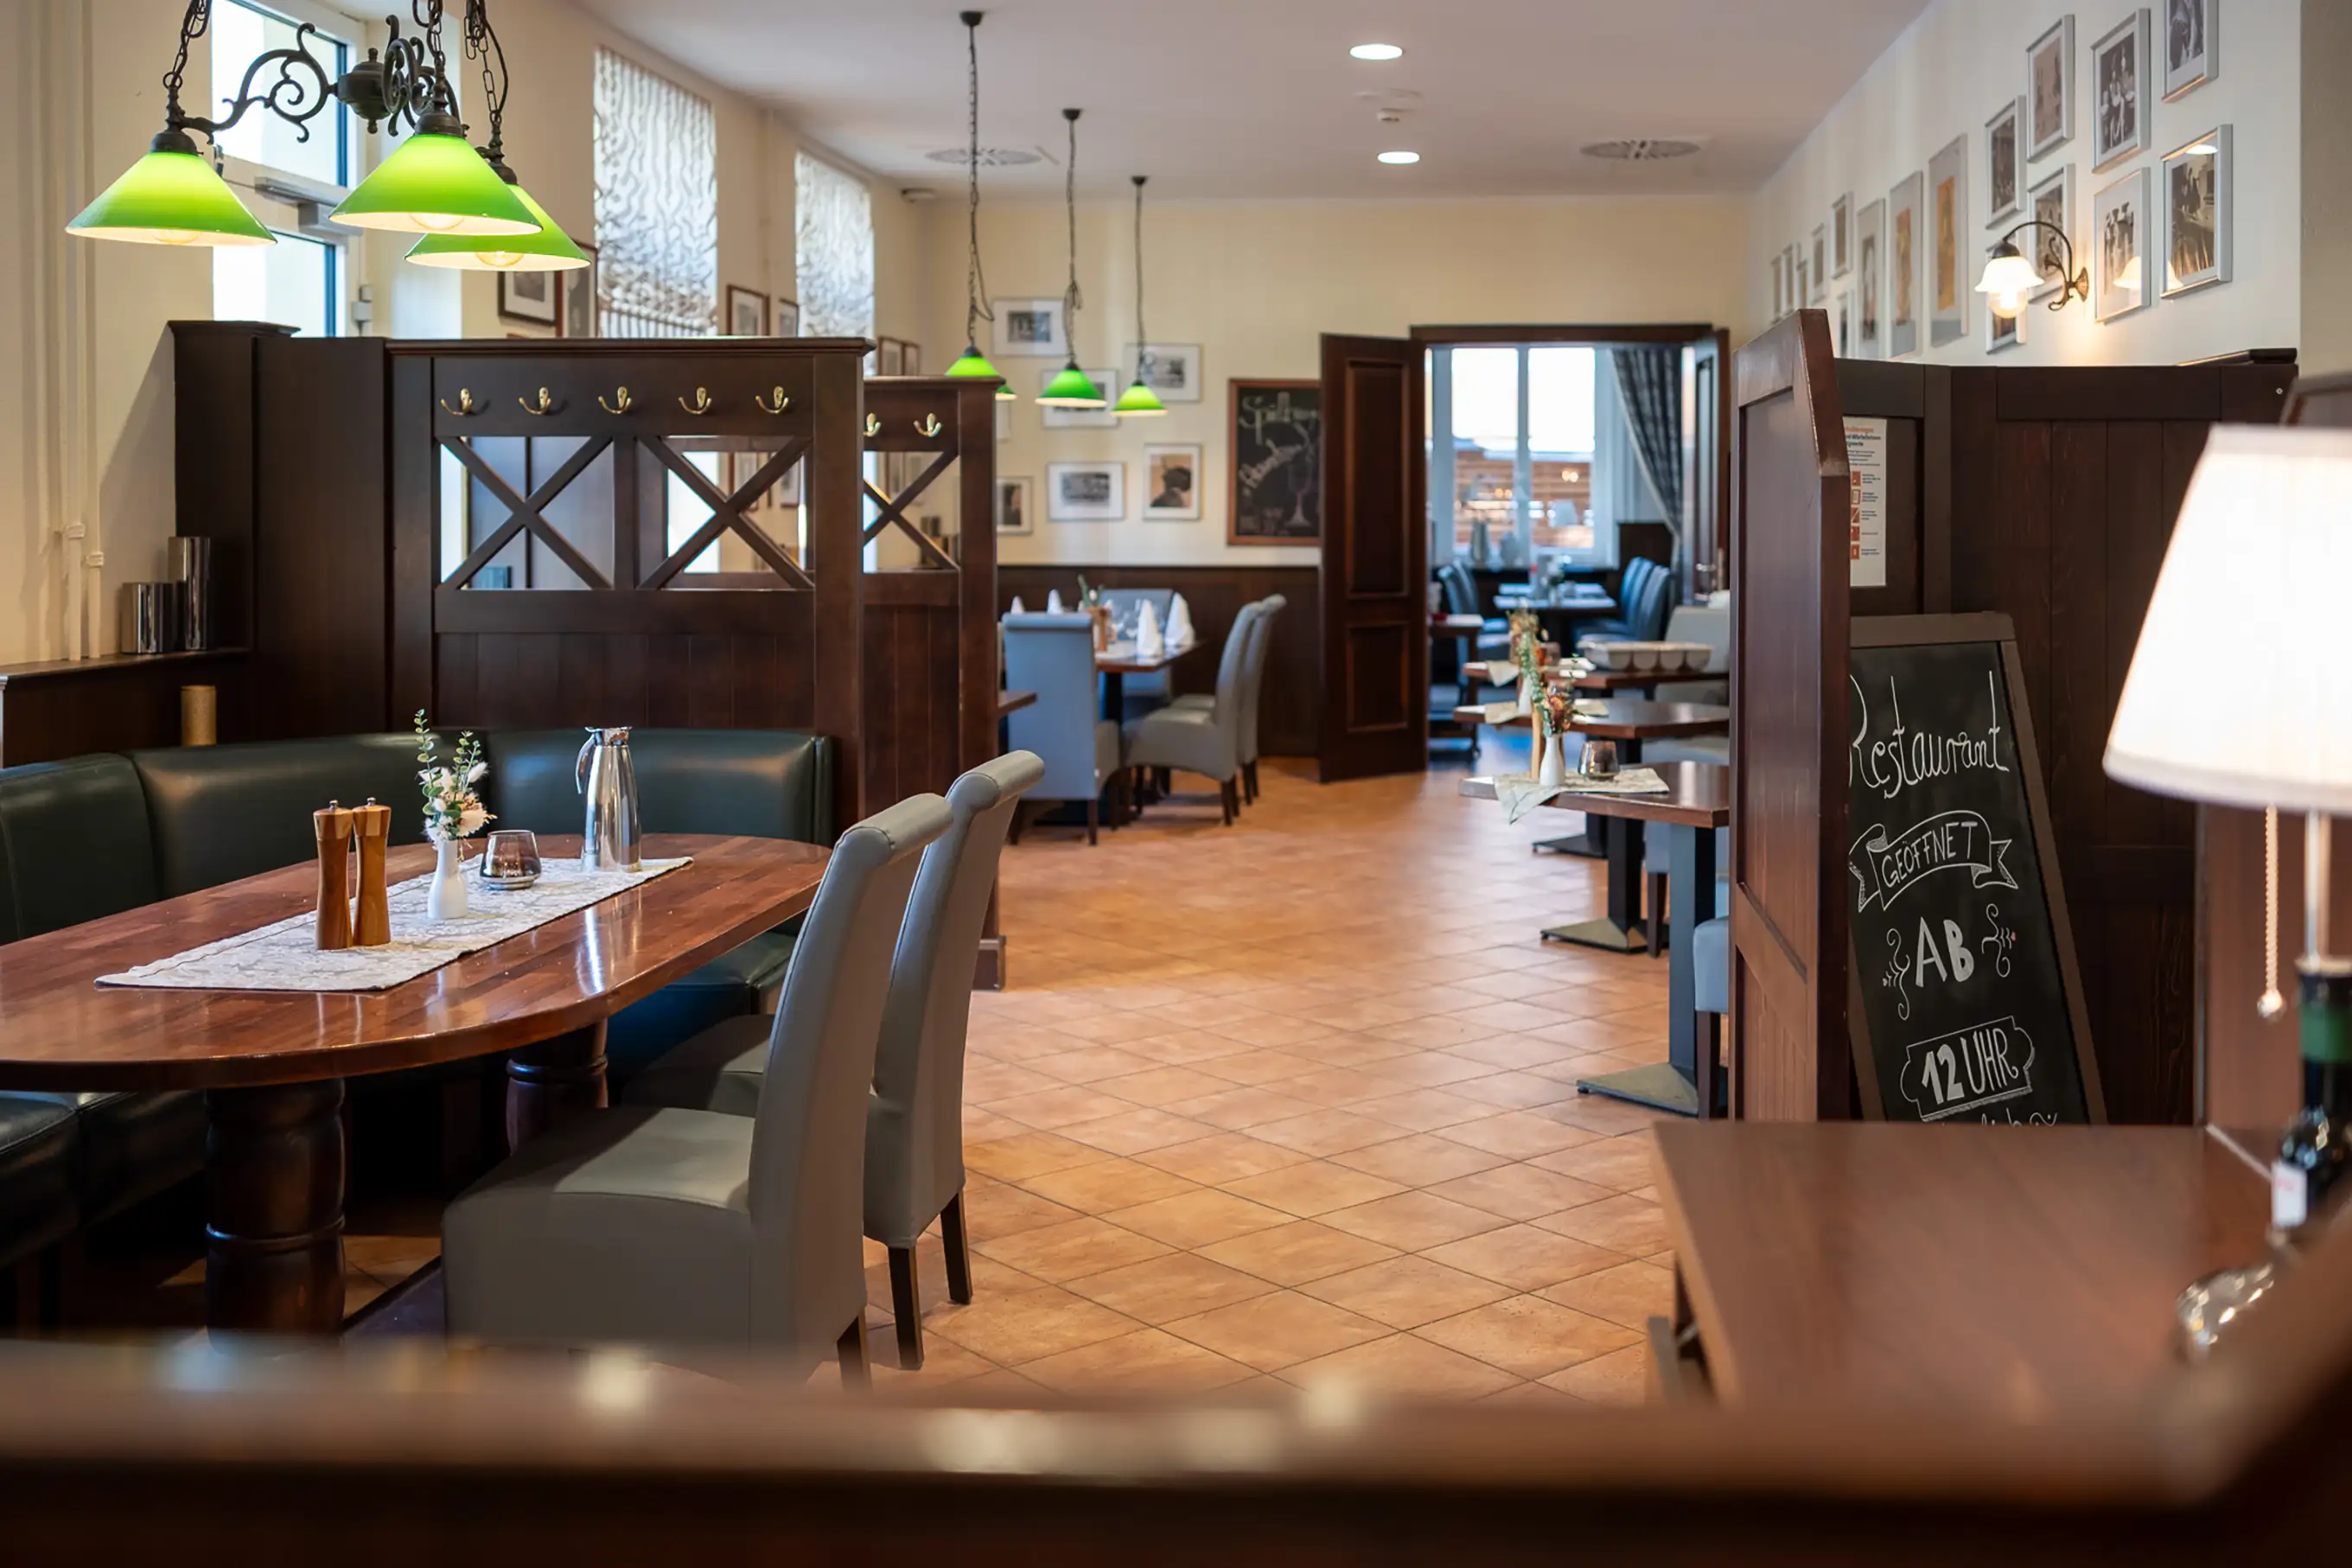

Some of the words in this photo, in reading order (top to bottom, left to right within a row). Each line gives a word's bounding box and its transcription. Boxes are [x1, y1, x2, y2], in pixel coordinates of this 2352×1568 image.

[1848, 670, 2010, 800] Restaurant
[1881, 821, 1979, 889] GEÖFFNET
[1915, 916, 1975, 988] AB
[1921, 1043, 1965, 1106] 12
[1960, 1028, 2019, 1094] UHR
